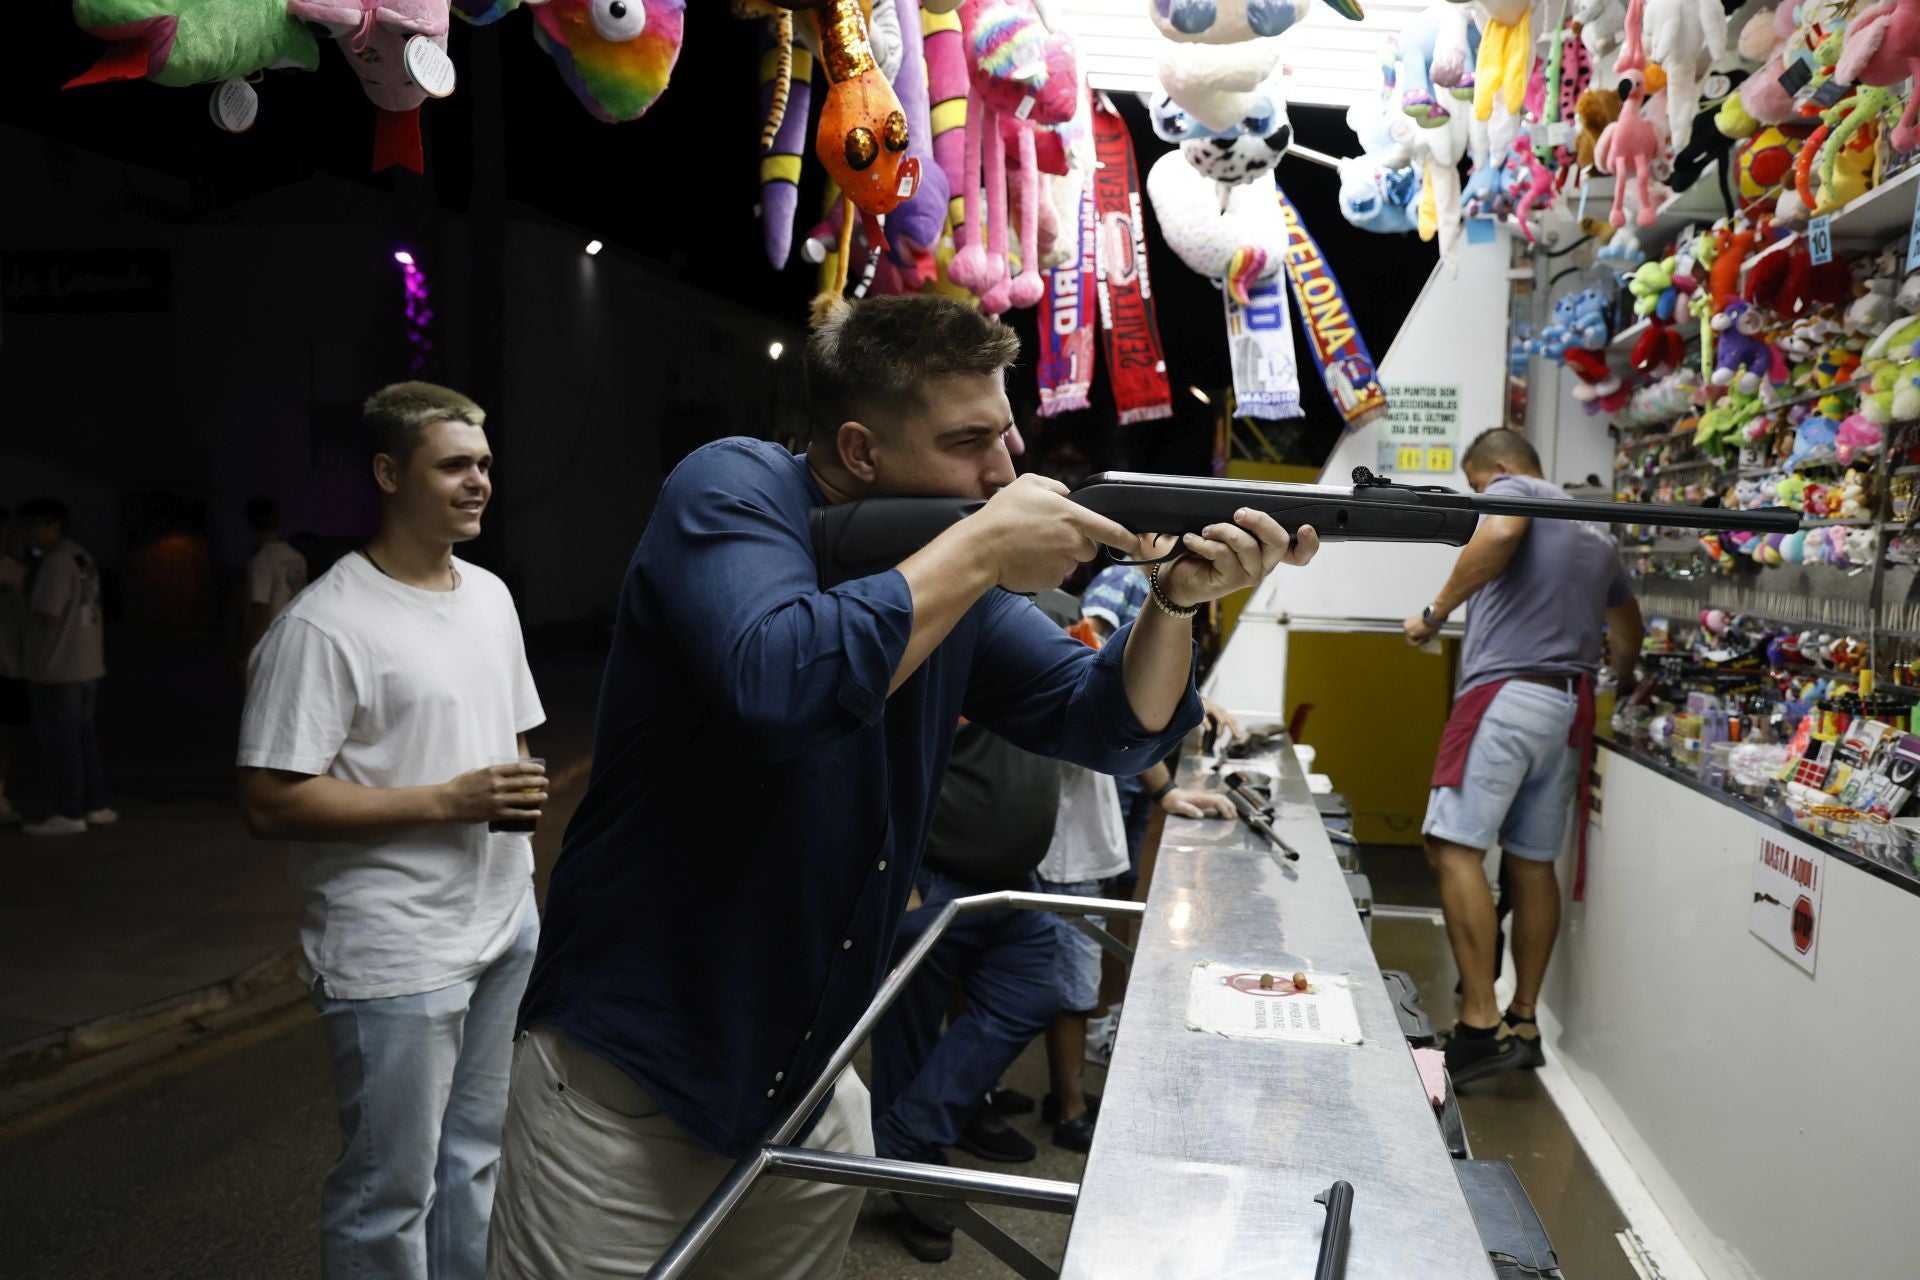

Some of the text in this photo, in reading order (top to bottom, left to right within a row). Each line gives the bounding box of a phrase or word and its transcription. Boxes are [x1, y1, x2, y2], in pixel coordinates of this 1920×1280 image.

[1812, 230, 1827, 255] 10
[1276, 190, 1356, 355] RCELONA
[1387, 400, 1457, 410] OLECCIONABLES
